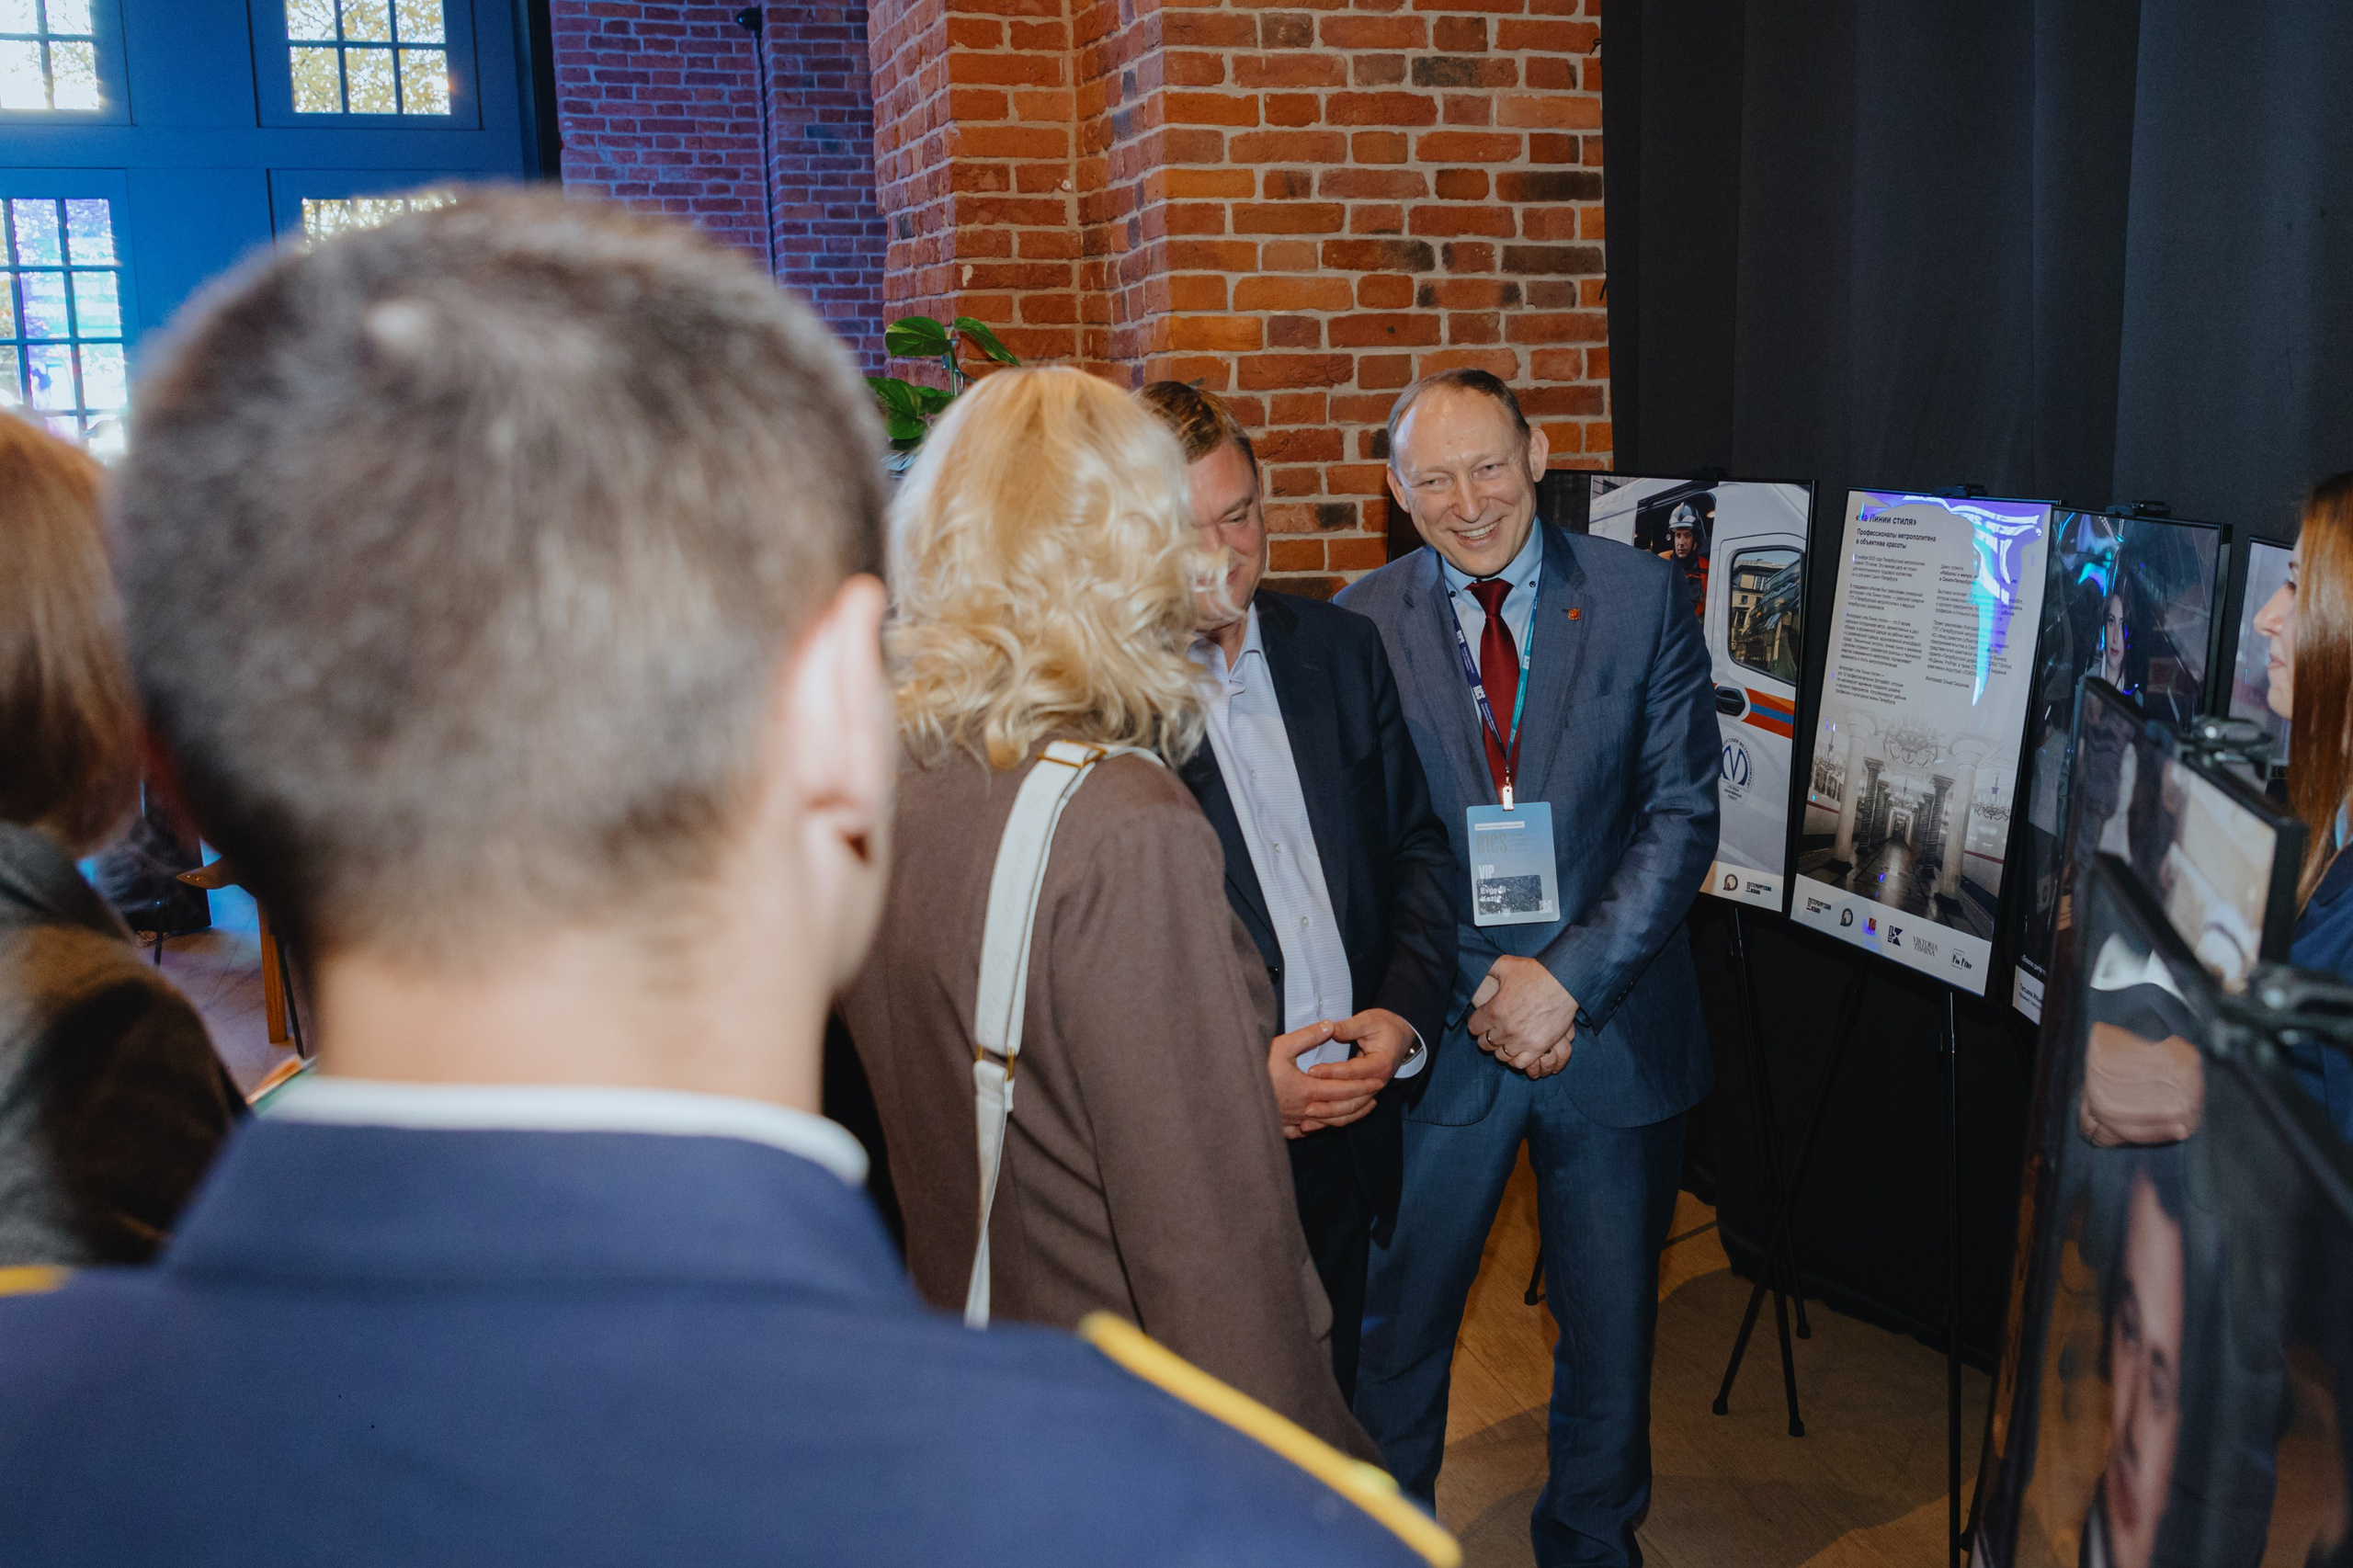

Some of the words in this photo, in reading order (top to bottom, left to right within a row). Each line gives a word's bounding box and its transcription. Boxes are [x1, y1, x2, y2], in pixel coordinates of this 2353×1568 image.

[1870, 515, 1892, 524] Линии
[1893, 517, 1917, 527] стиля»
[1857, 528, 1897, 540] Профессионалы
[1898, 532, 1937, 543] метрополитена
[1859, 539, 1886, 548] объективе
[1887, 541, 1907, 550] красоты
[1472, 685, 1486, 700] RICS
[1478, 864, 1495, 879] VIP
[1913, 936, 1938, 951] VIKTORIA
[1914, 943, 1936, 957] TISHINA
